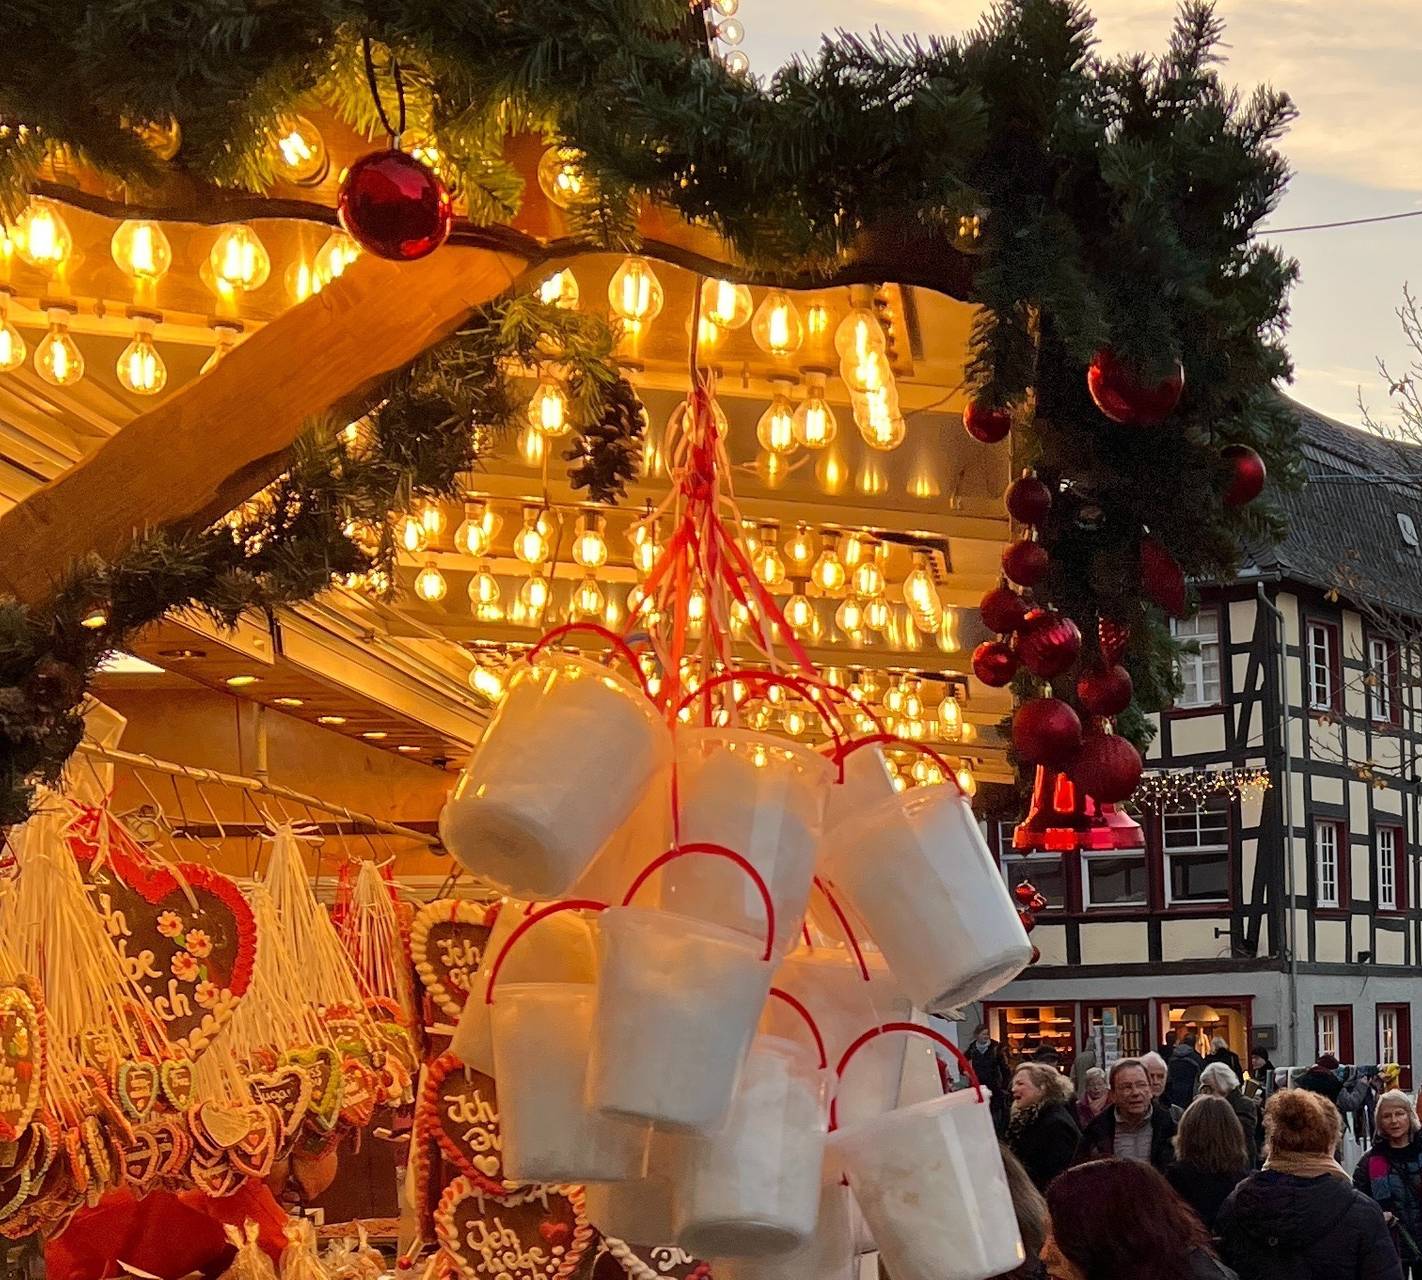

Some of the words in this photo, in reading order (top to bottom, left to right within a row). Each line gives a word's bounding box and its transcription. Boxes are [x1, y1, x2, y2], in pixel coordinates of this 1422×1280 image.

[436, 939, 481, 967] Ich
[443, 1089, 500, 1124] Ich
[462, 1124, 503, 1152] Di
[466, 1217, 520, 1250] Ich
